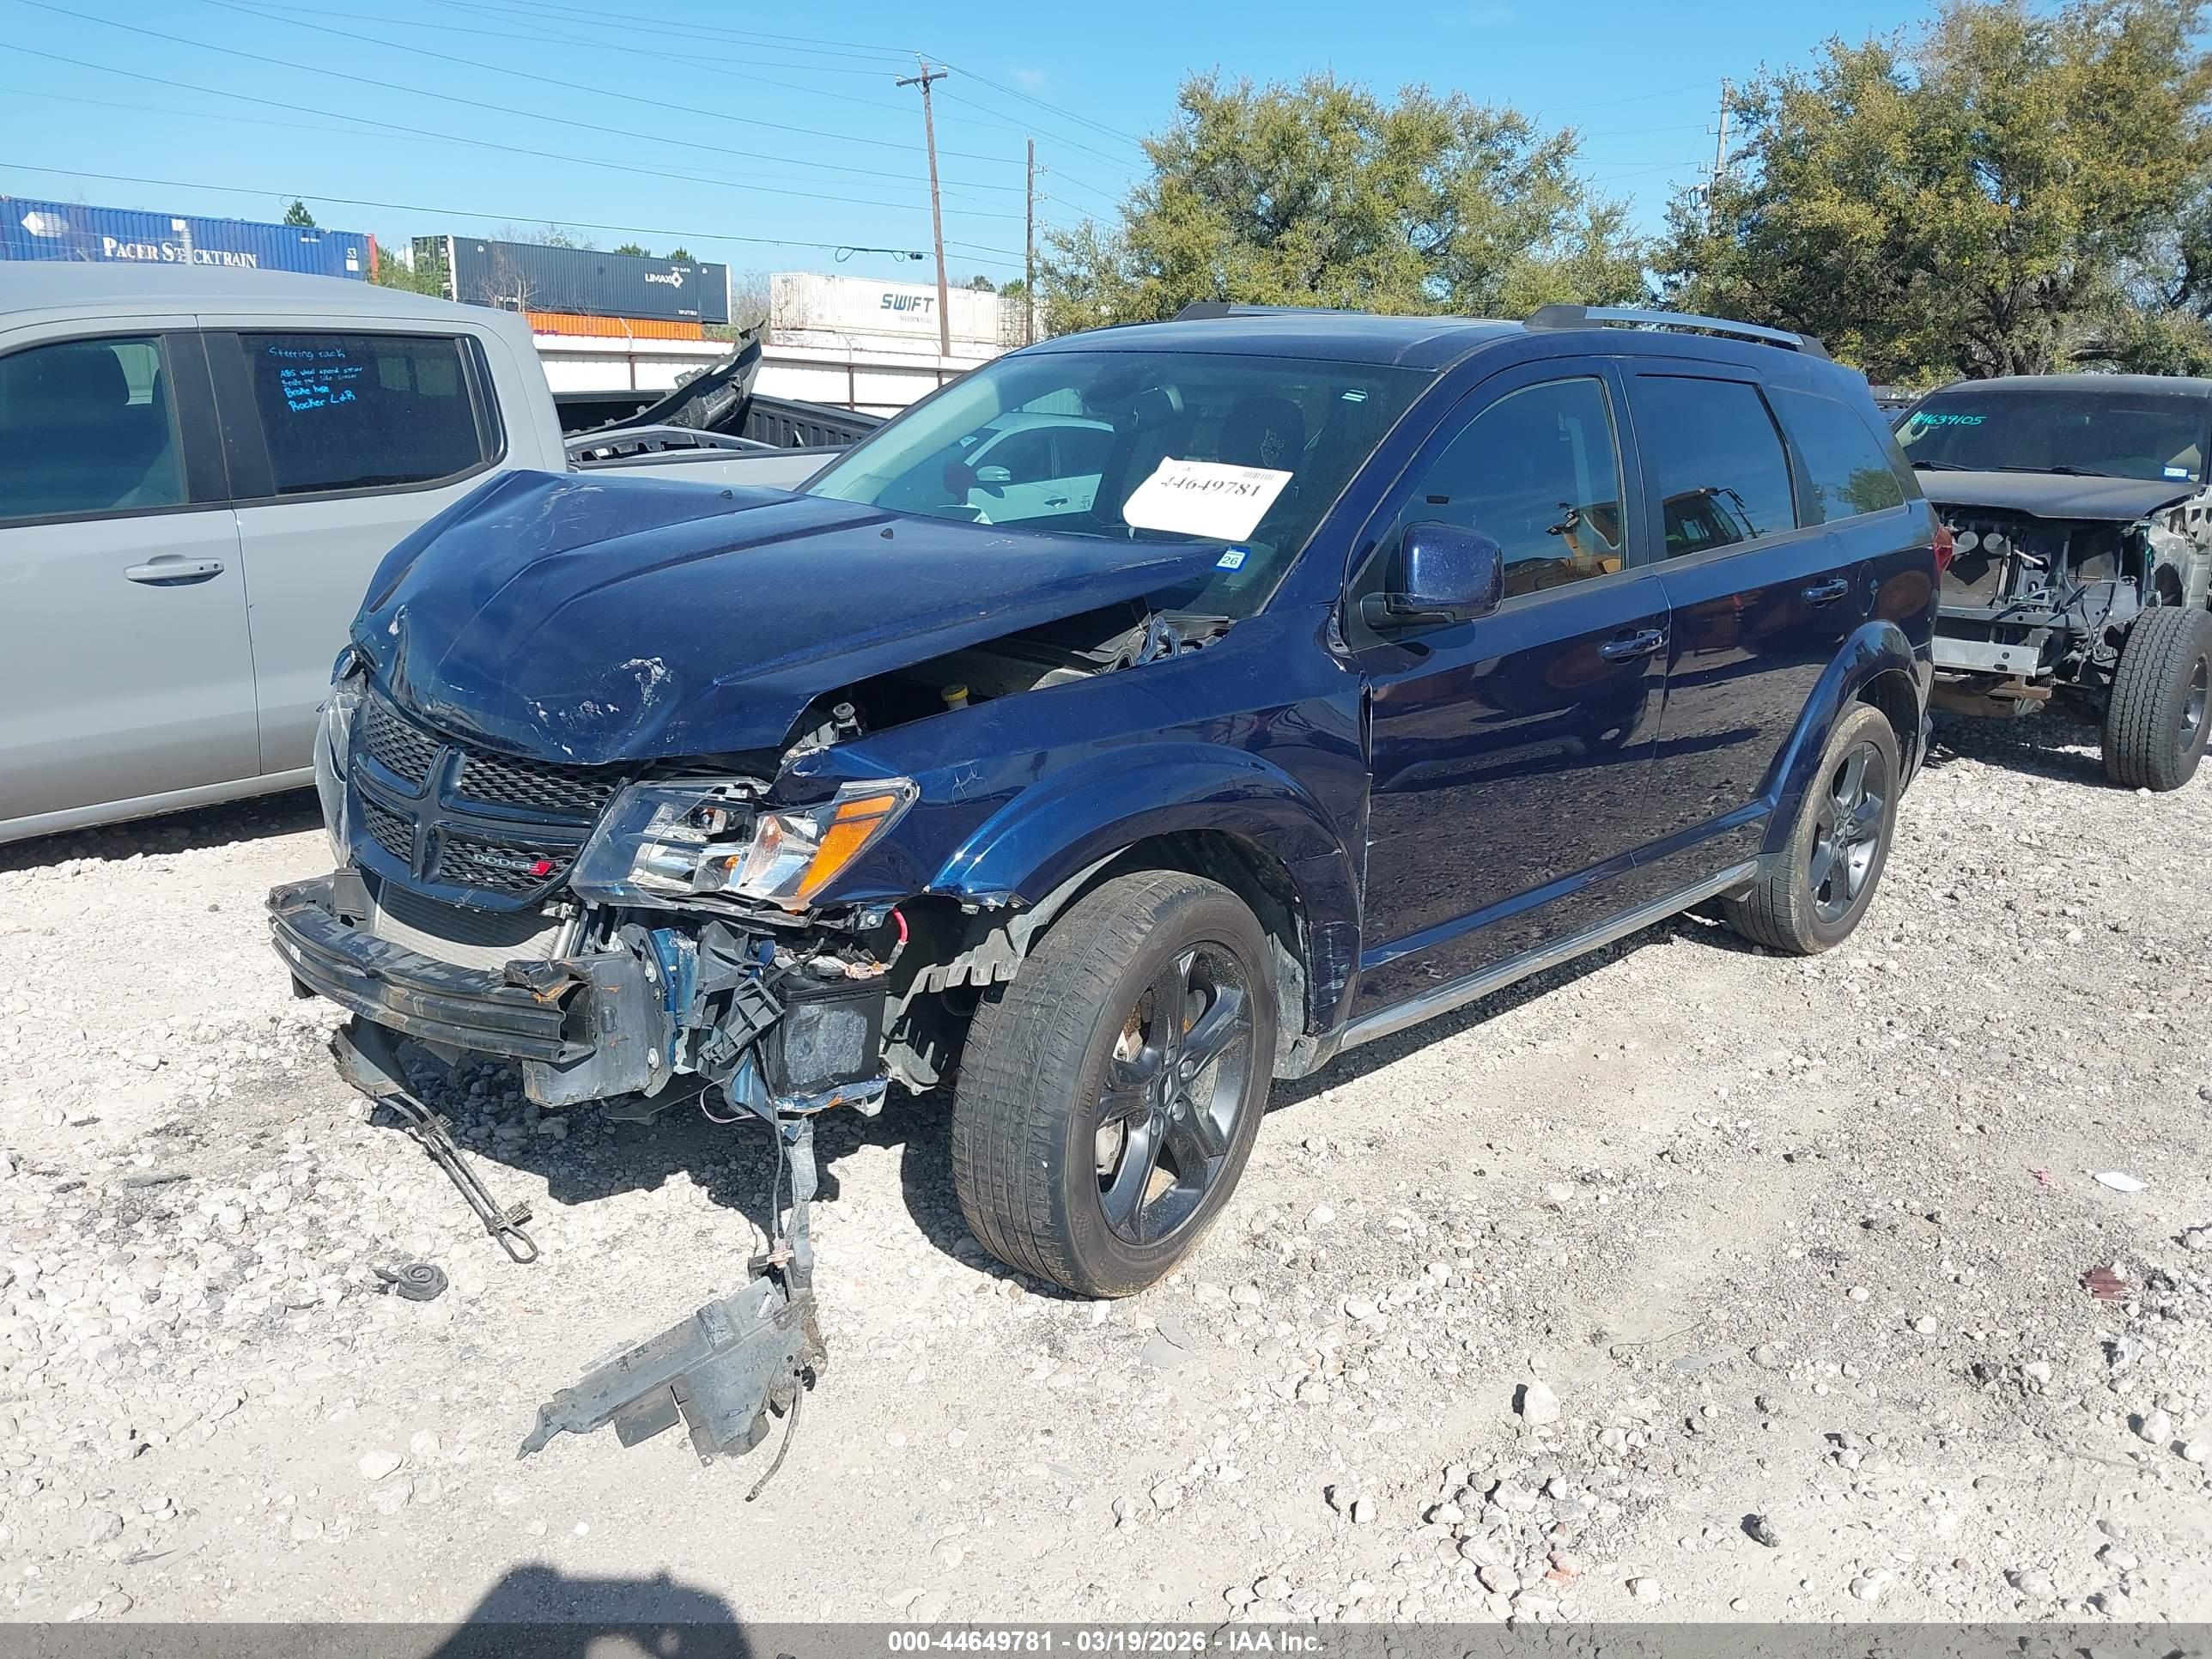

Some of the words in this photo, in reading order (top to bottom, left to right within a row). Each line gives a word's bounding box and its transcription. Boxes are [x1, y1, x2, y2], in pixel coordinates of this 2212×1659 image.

[102, 237, 159, 261] PACER
[347, 247, 357, 259] 53
[880, 293, 935, 313] SWIFT
[280, 369, 296, 379] ABS
[1911, 412, 1988, 425] 44639105
[1161, 476, 1261, 497] 44649781
[1221, 556, 1239, 566] 26
[473, 854, 538, 871] DODGE
